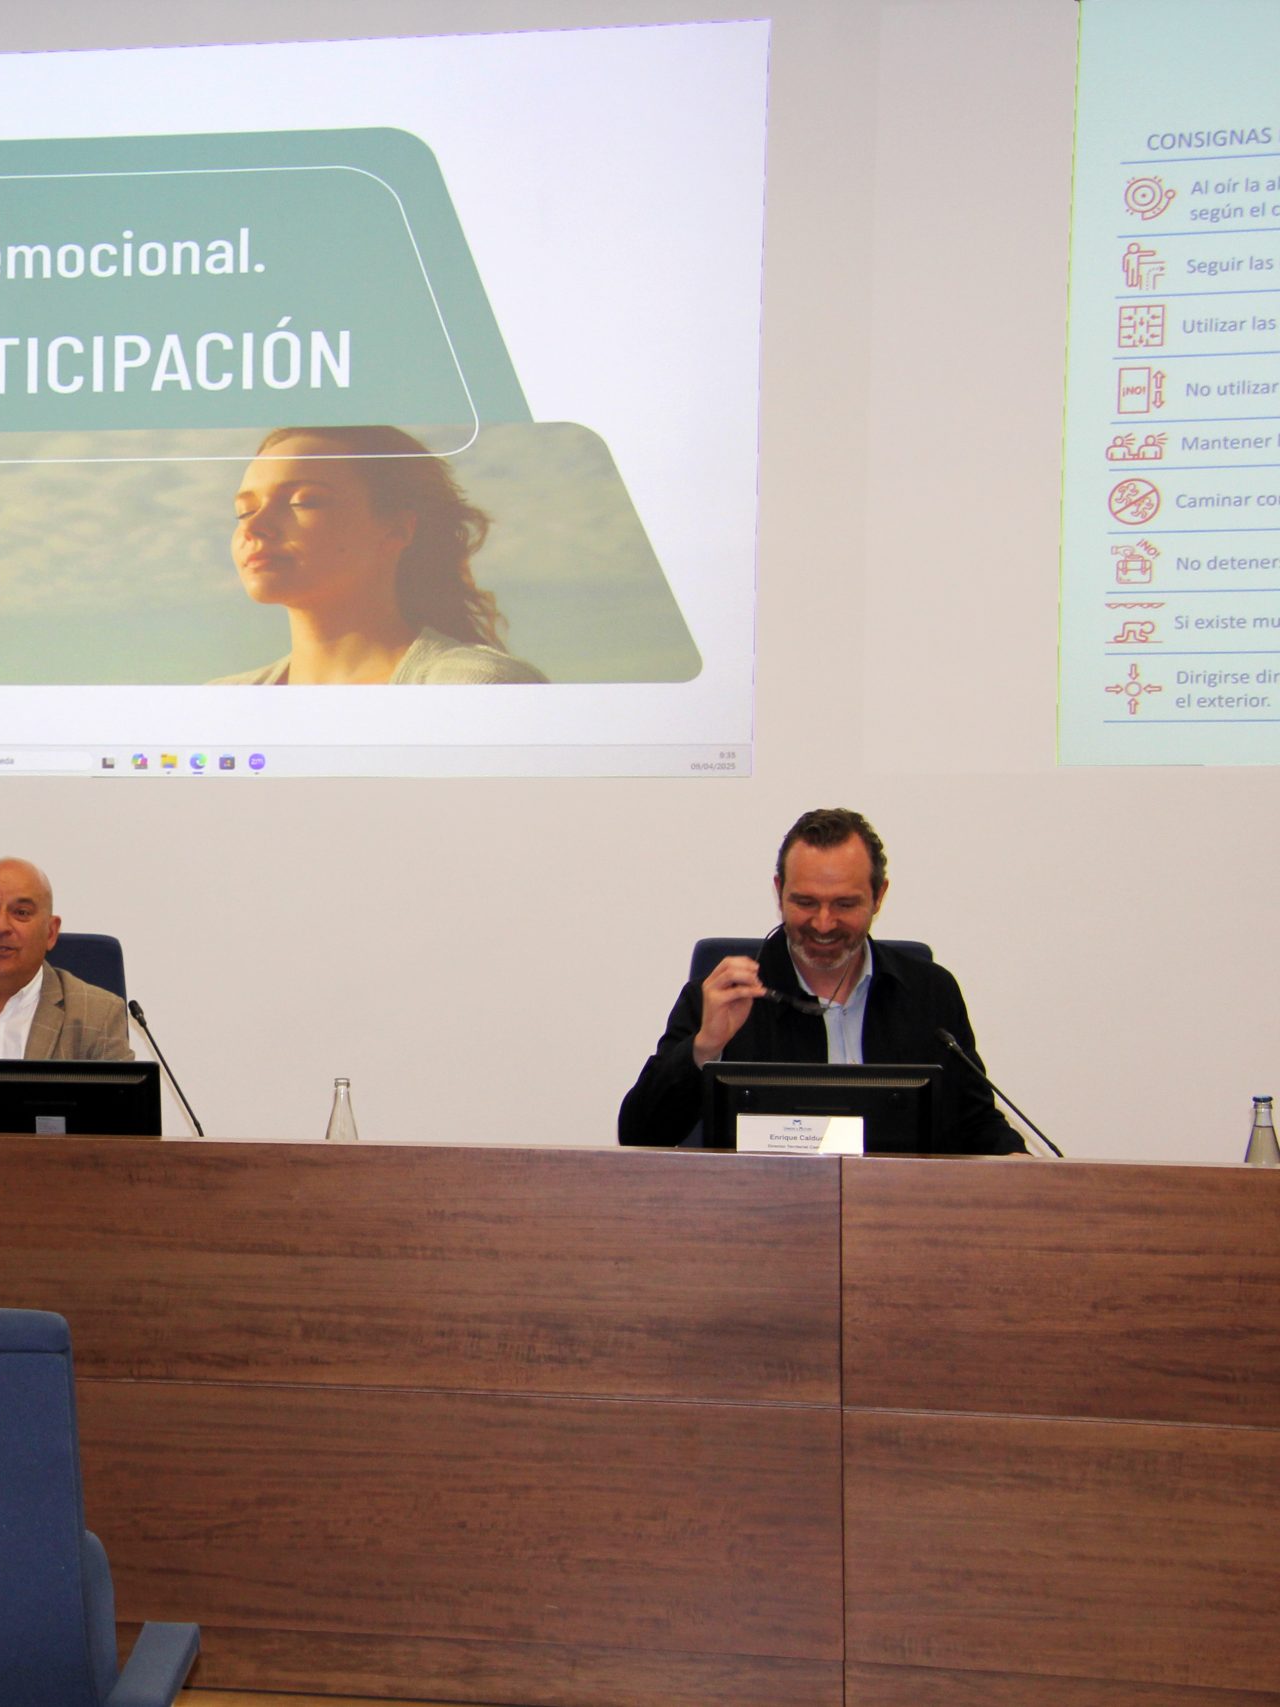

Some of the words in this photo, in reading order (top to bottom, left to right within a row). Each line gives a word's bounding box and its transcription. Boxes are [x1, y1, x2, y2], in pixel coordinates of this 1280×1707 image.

[1146, 127, 1272, 150] CONSIGNAS
[1191, 180, 1208, 195] Al
[1214, 177, 1239, 194] oír
[1245, 177, 1260, 192] la
[1190, 202, 1243, 223] según
[1250, 202, 1265, 217] el
[1186, 257, 1244, 276] Seguir
[1249, 255, 1274, 271] las
[1182, 317, 1247, 334] Utilizar
[1252, 315, 1277, 331] las
[1185, 382, 1211, 397] No
[1217, 380, 1280, 396] utilizar
[1181, 436, 1272, 451] Mantener
[1175, 493, 1252, 509] Caminar
[1257, 494, 1280, 507] co
[1176, 557, 1201, 571] No
[1207, 556, 1280, 570] detener
[1174, 615, 1189, 630] Si
[1194, 614, 1247, 630] existe
[1176, 670, 1250, 688] Dirigirse
[1175, 693, 1191, 708] el
[1196, 693, 1271, 708] exterior.
[769, 1134, 798, 1142] Enrique
